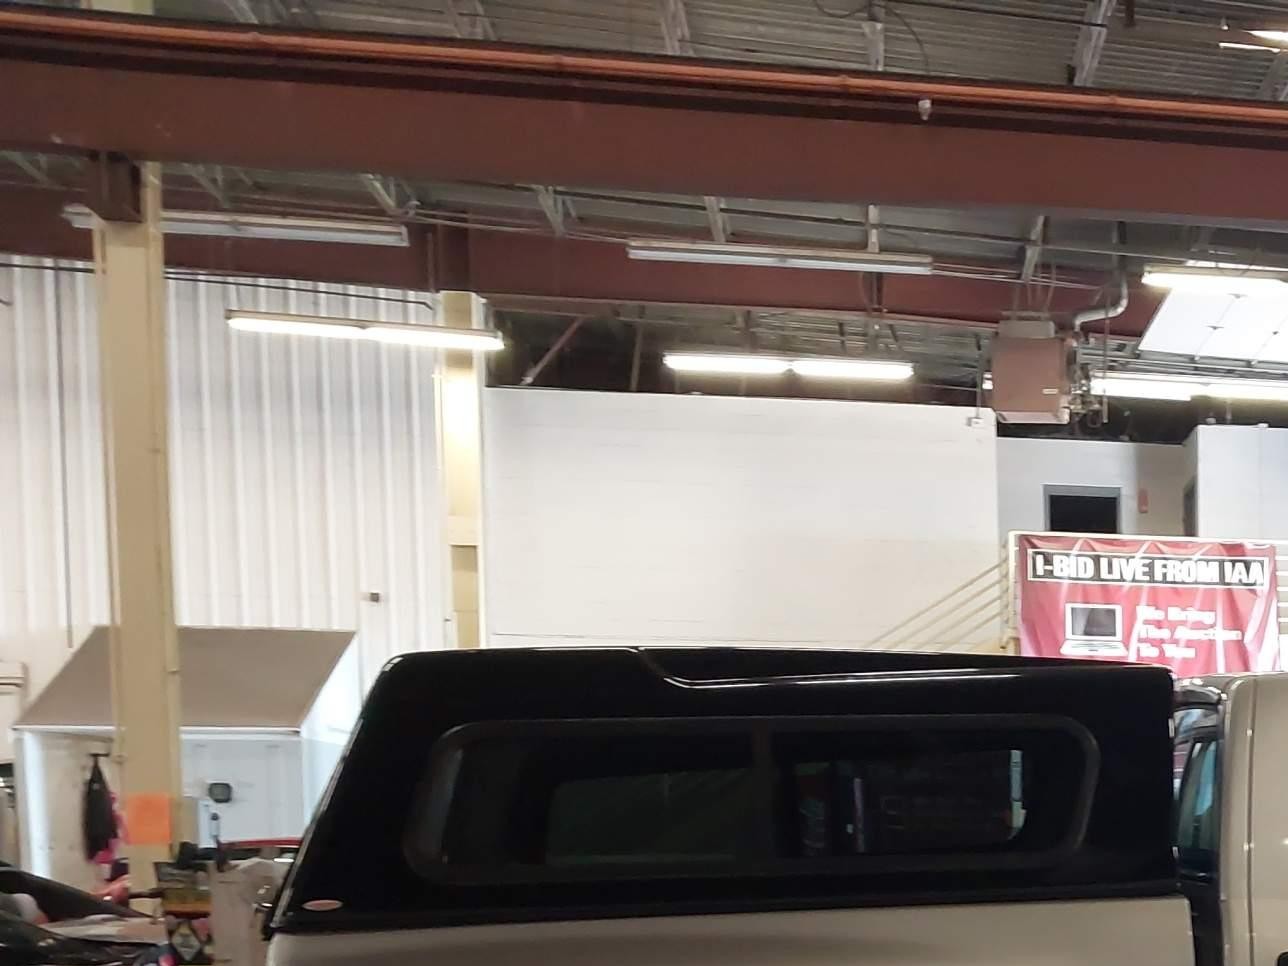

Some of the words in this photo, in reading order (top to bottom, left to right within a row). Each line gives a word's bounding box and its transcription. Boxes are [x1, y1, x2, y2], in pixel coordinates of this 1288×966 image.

[1035, 554, 1094, 579] I-BID
[1099, 557, 1150, 581] LIVE
[1154, 560, 1219, 583] FROM
[1223, 561, 1265, 585] IAA
